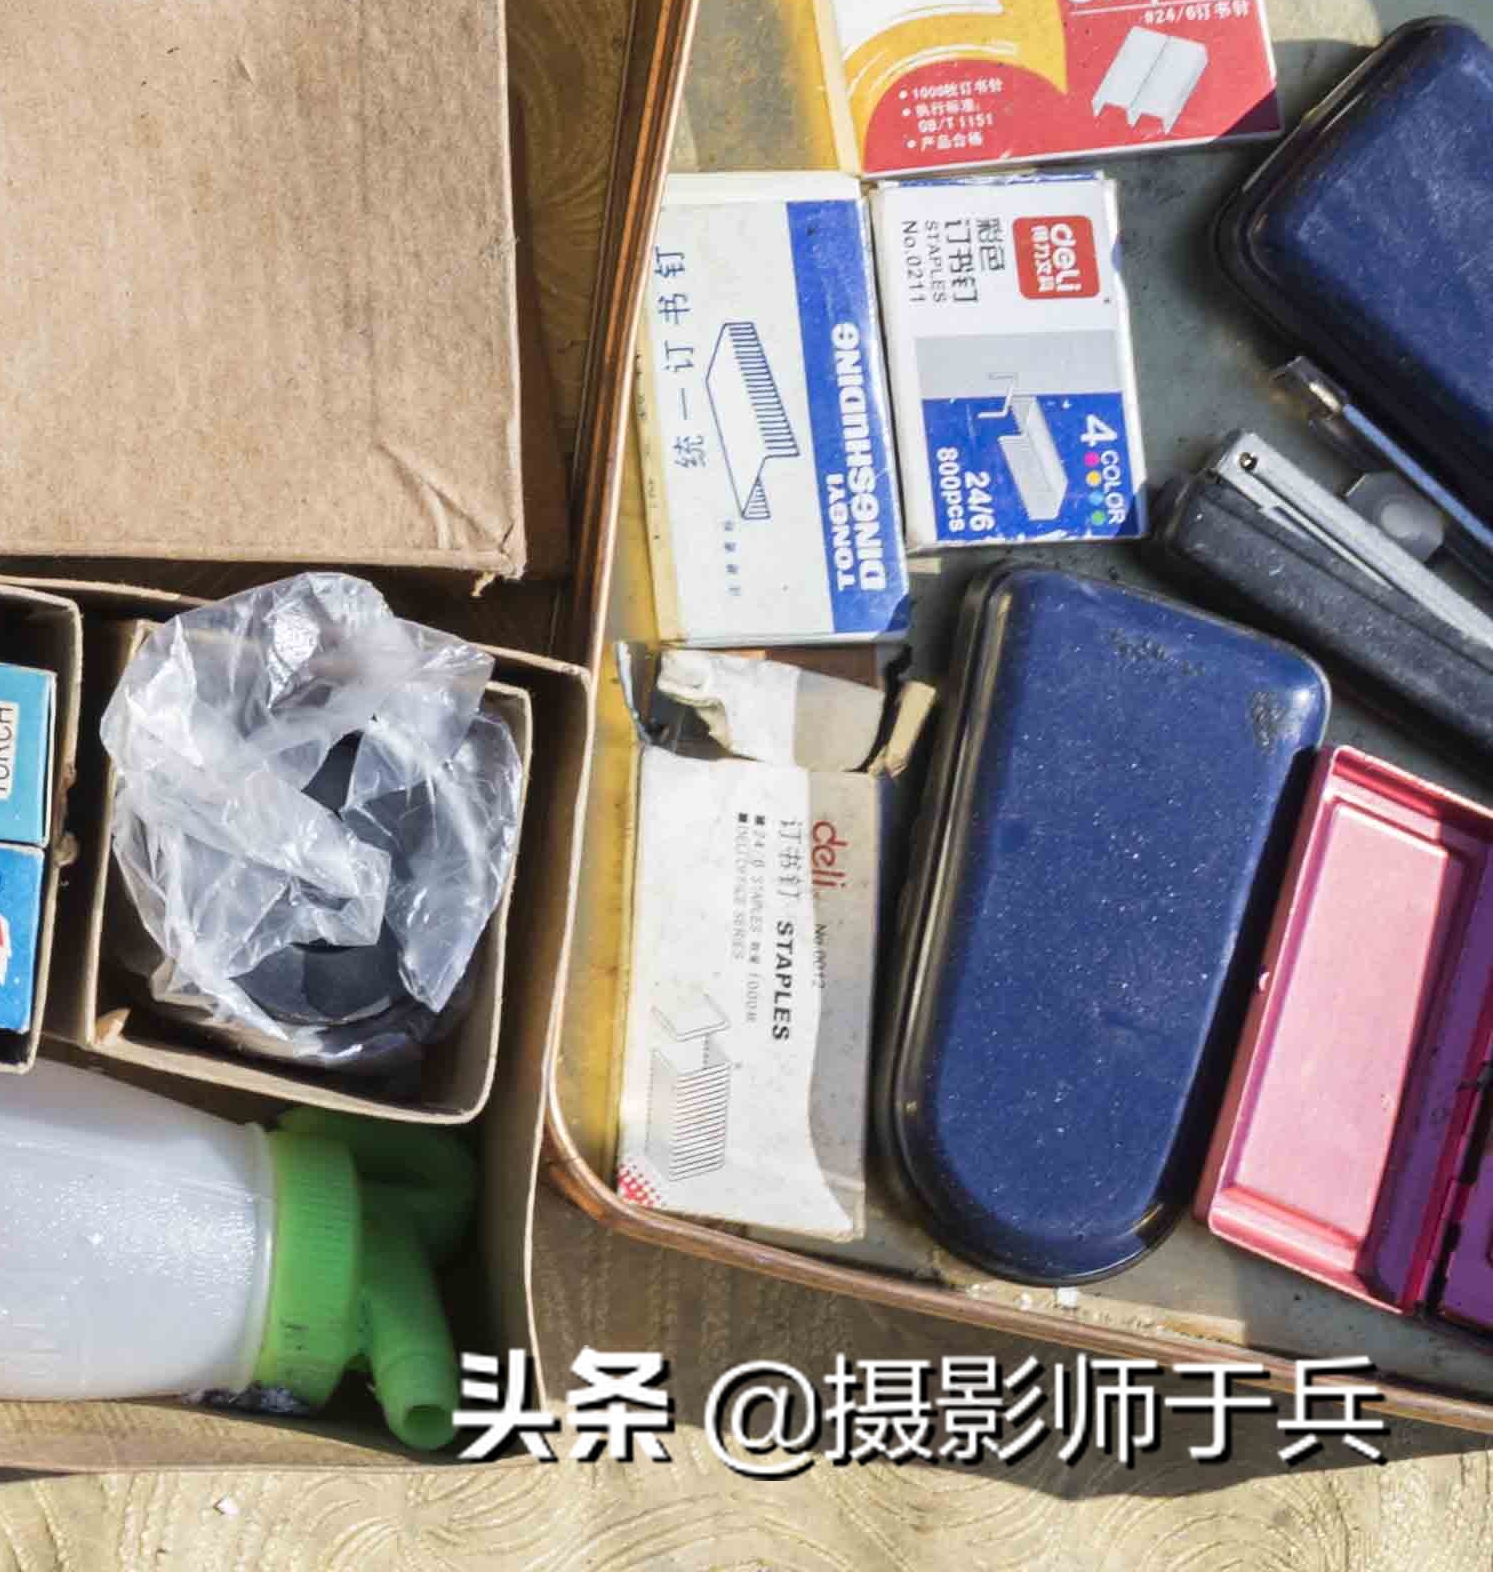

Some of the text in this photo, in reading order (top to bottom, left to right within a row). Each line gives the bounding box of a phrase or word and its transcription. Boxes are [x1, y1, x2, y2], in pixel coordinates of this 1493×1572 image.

[924, 219, 948, 304] STAPLES
[944, 219, 979, 303] 订书钉
[975, 218, 1006, 271] 彩色
[1049, 222, 1082, 293] deli
[654, 247, 707, 470] 统一订书钉
[829, 322, 886, 591] DINGSHUDING
[936, 447, 966, 532] 800pcs
[1080, 413, 1125, 525] 4 COLOR
[826, 474, 856, 590] TONGYI
[964, 471, 995, 532] 24/6
[811, 820, 848, 888] deli
[772, 920, 795, 1042] STAPLES
